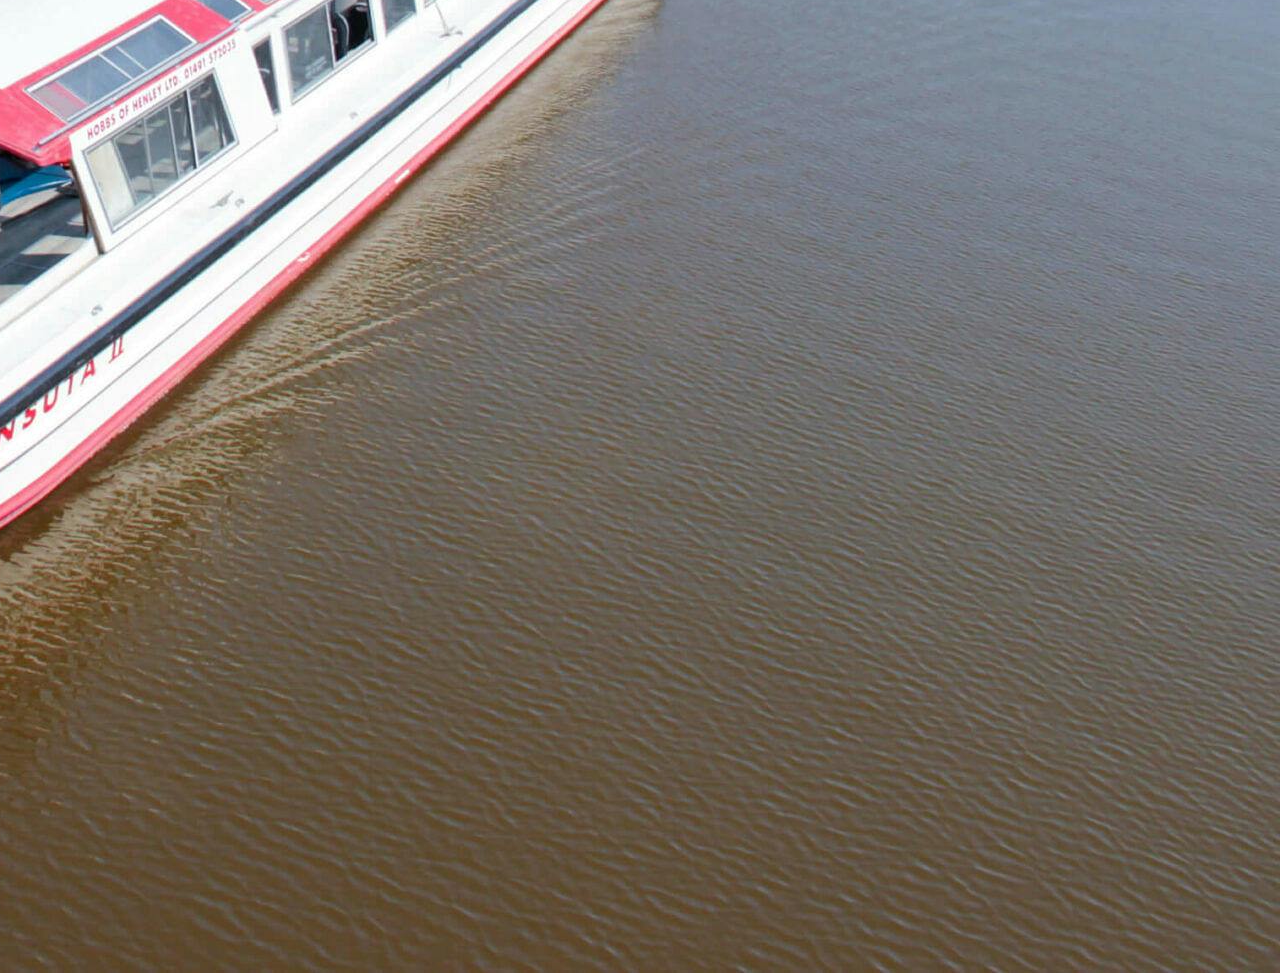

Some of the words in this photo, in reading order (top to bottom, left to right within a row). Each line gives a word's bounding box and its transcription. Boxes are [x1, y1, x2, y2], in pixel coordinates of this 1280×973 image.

[86, 113, 117, 140] HOBBS
[119, 105, 130, 120] OF
[132, 86, 162, 111] HENLEY
[164, 75, 181, 93] LTD.
[183, 57, 206, 79] 01491
[208, 39, 237, 65] 572035
